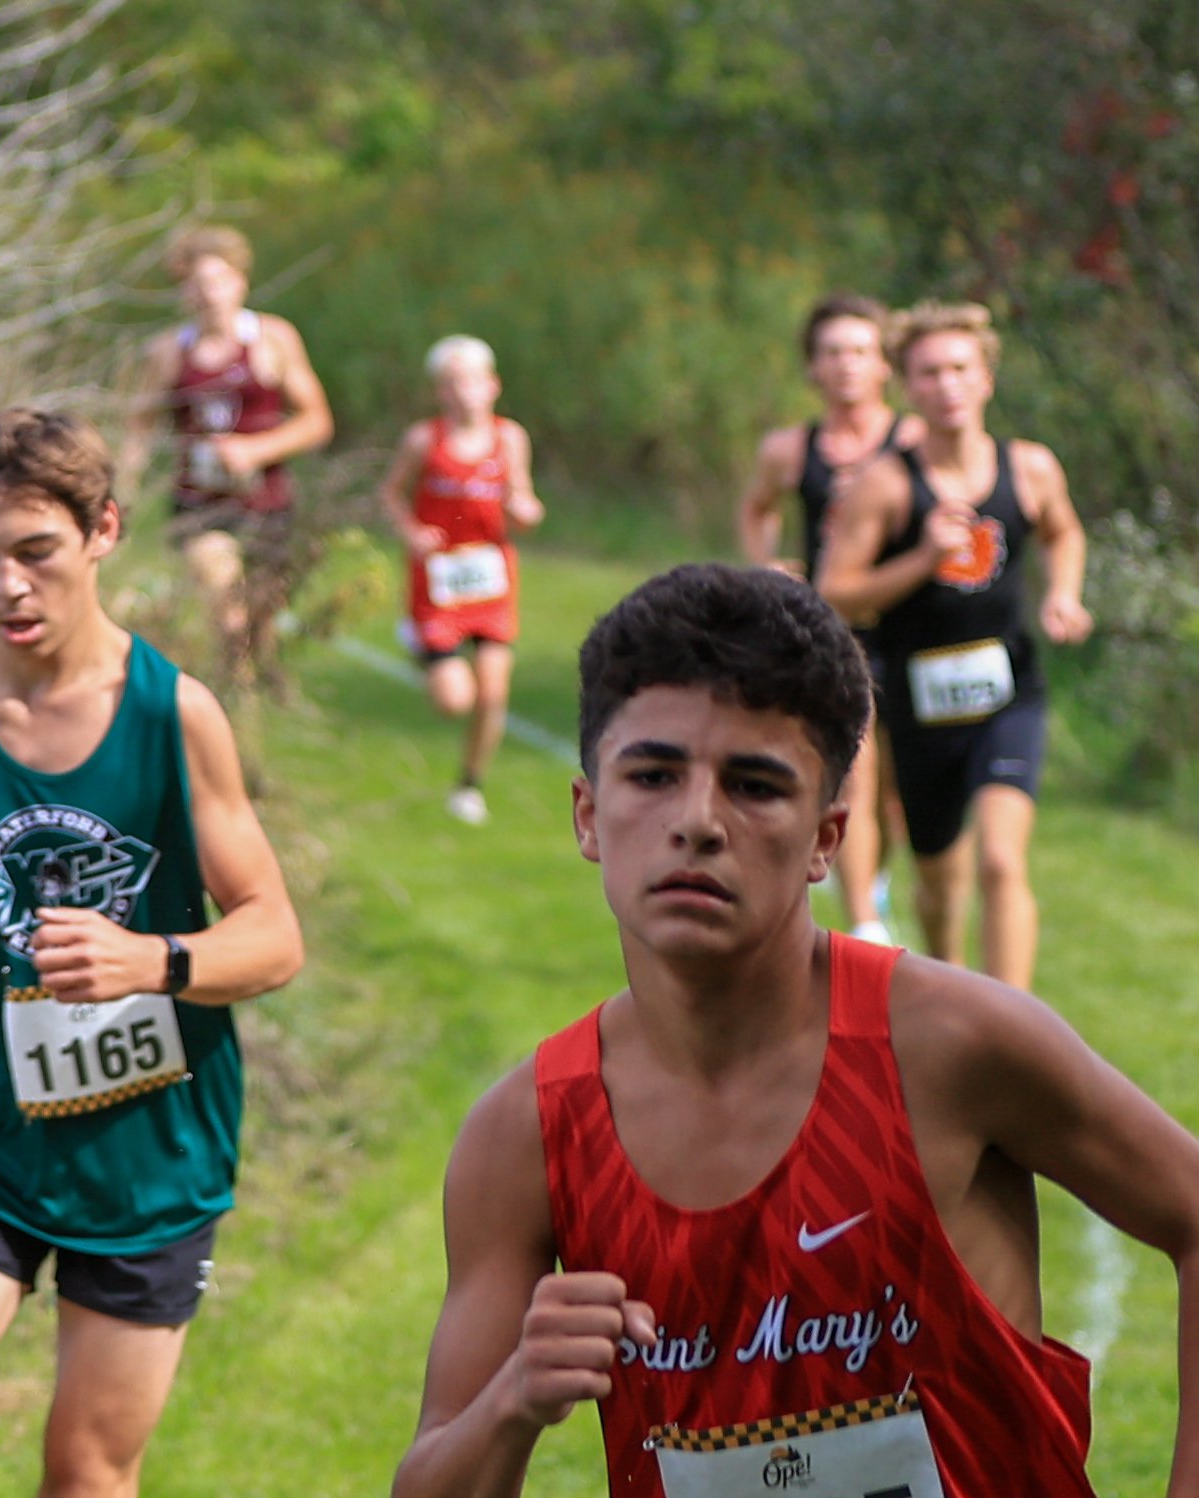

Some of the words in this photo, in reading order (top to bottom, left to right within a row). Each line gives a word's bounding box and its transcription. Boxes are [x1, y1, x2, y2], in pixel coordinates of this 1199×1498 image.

[27, 1018, 165, 1093] 1165
[617, 1325, 718, 1373] int
[735, 1284, 919, 1374] Mary's
